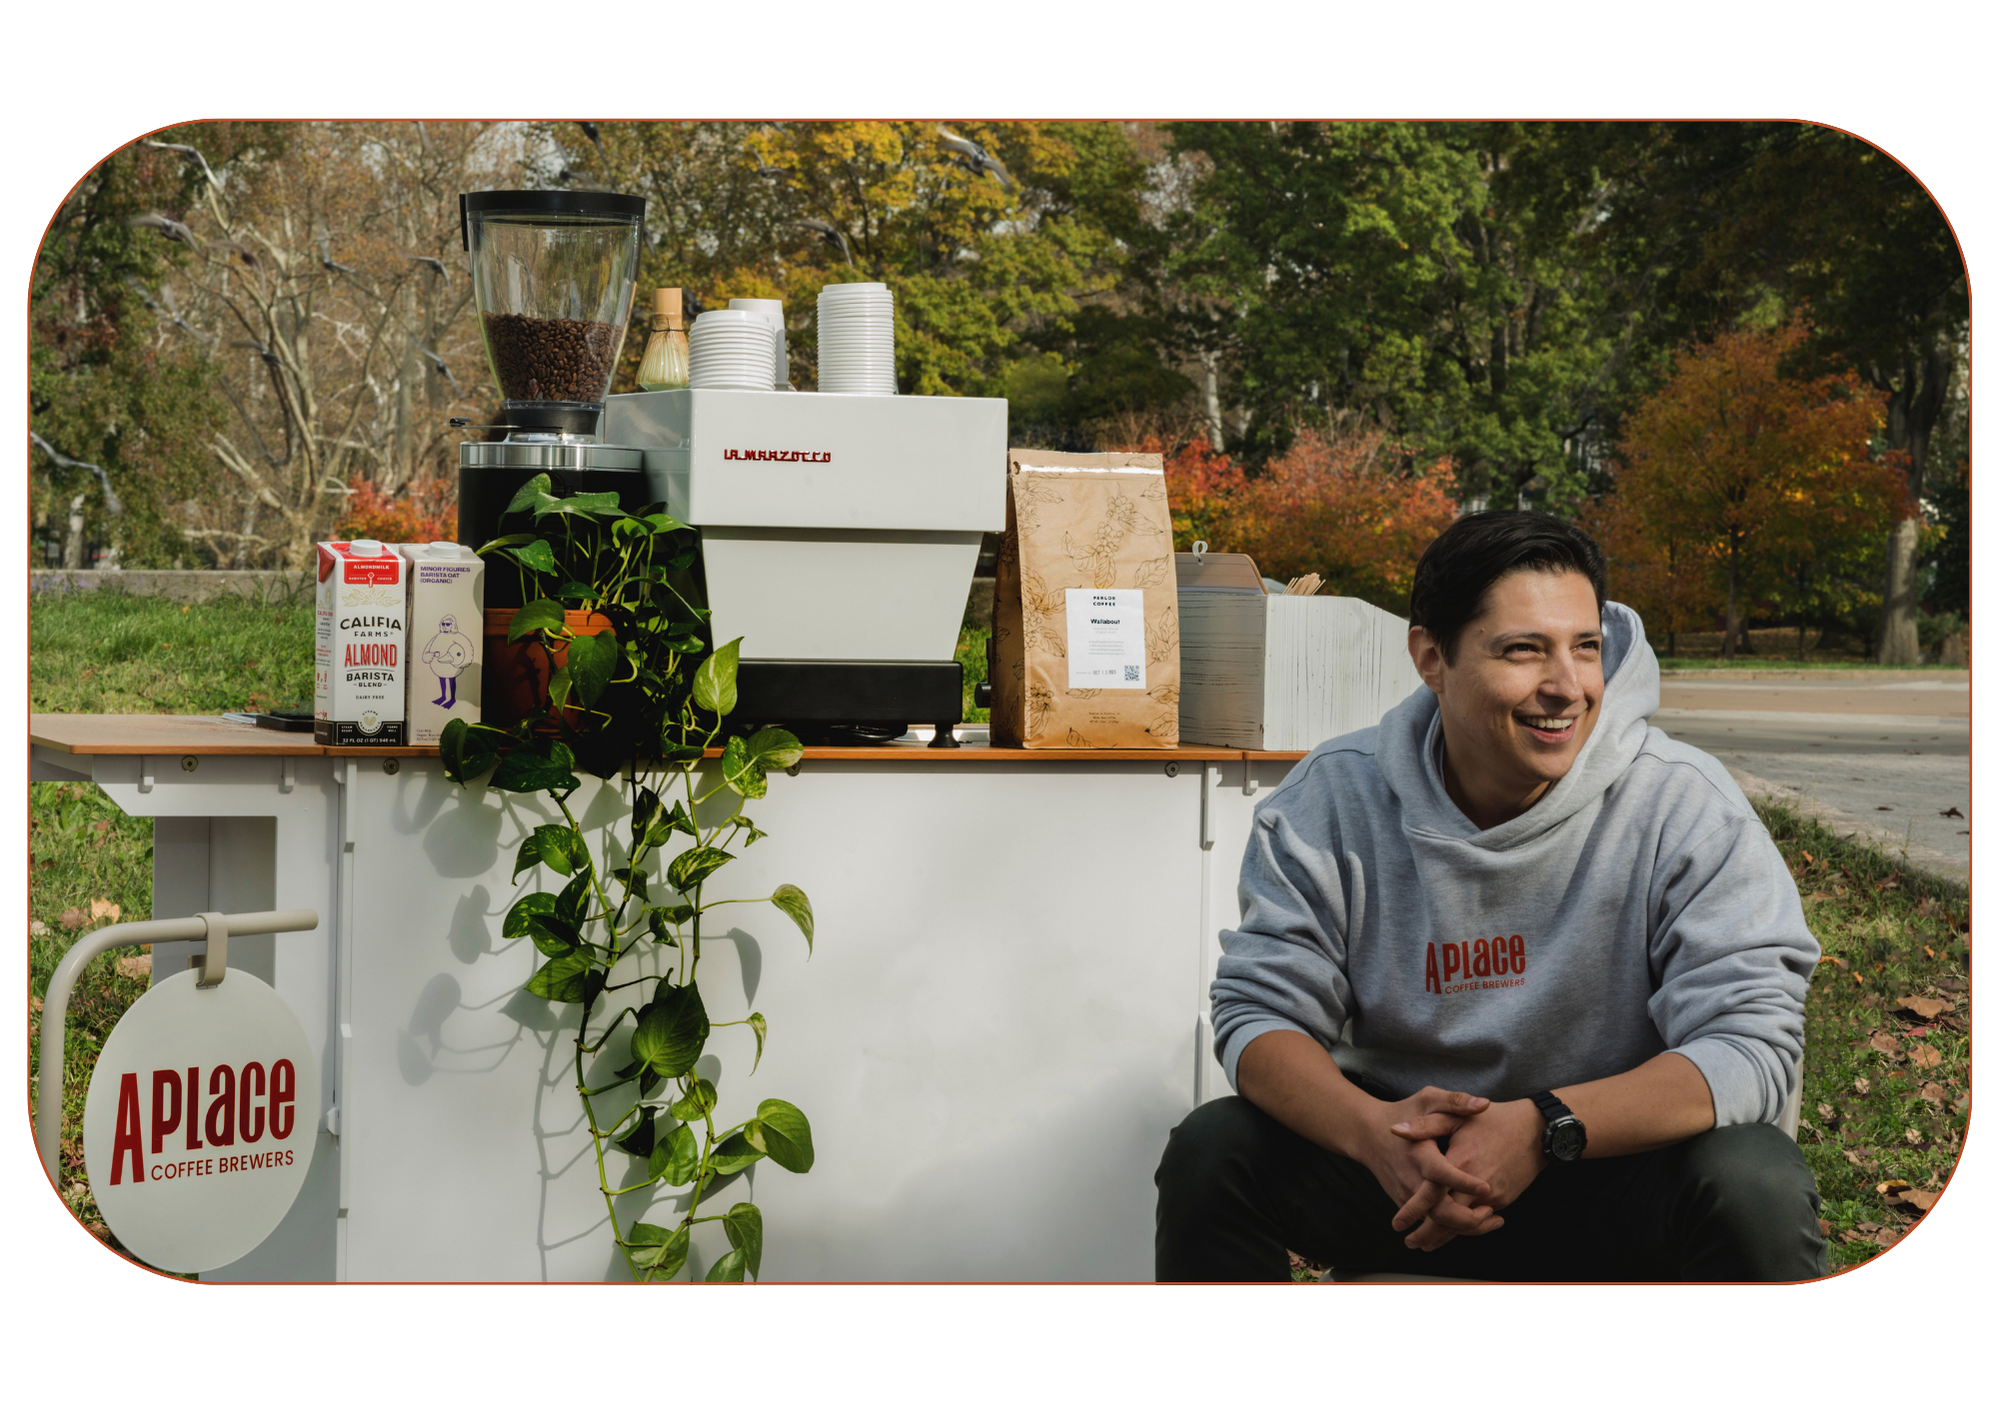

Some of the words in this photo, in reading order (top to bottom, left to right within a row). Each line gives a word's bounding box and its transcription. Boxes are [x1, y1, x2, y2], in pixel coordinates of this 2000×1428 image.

[340, 616, 402, 631] CALIFIA
[344, 643, 398, 668] ALMOND
[346, 672, 395, 682] BARISTA
[1425, 941, 1442, 995] A
[1444, 981, 1480, 995] COFFEE
[1482, 977, 1525, 990] BREWERS
[109, 1072, 145, 1186] A
[151, 1159, 213, 1181] COFFEE
[219, 1150, 294, 1174] BREWERS
